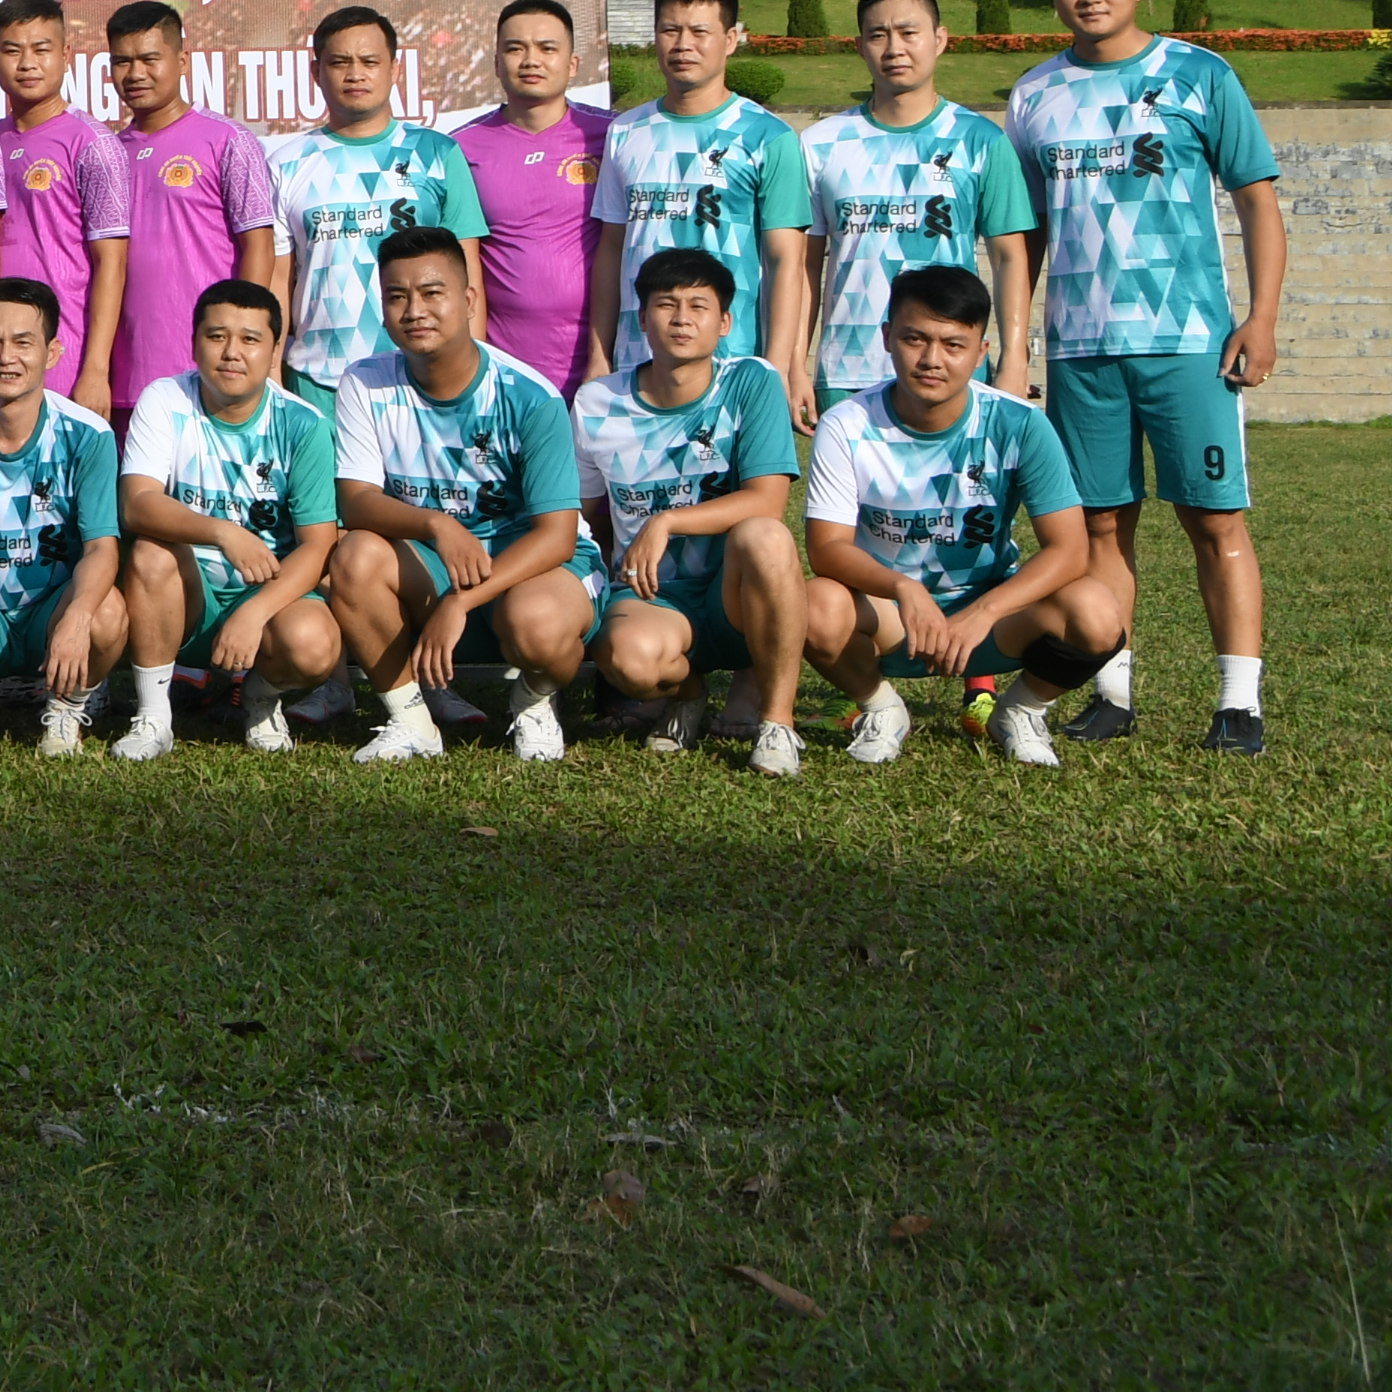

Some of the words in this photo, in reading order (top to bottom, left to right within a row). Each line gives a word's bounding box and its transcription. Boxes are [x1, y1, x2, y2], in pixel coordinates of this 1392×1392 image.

[1048, 140, 1125, 163] Standard
[629, 188, 690, 204] Standard
[311, 205, 382, 225] Standard
[841, 200, 916, 217] Standard
[841, 217, 917, 235] Chartered
[1203, 444, 1226, 481] 9
[392, 478, 468, 501] Standard
[617, 480, 693, 502] Standard
[872, 510, 954, 529] Standard
[869, 524, 956, 547] Chartered
